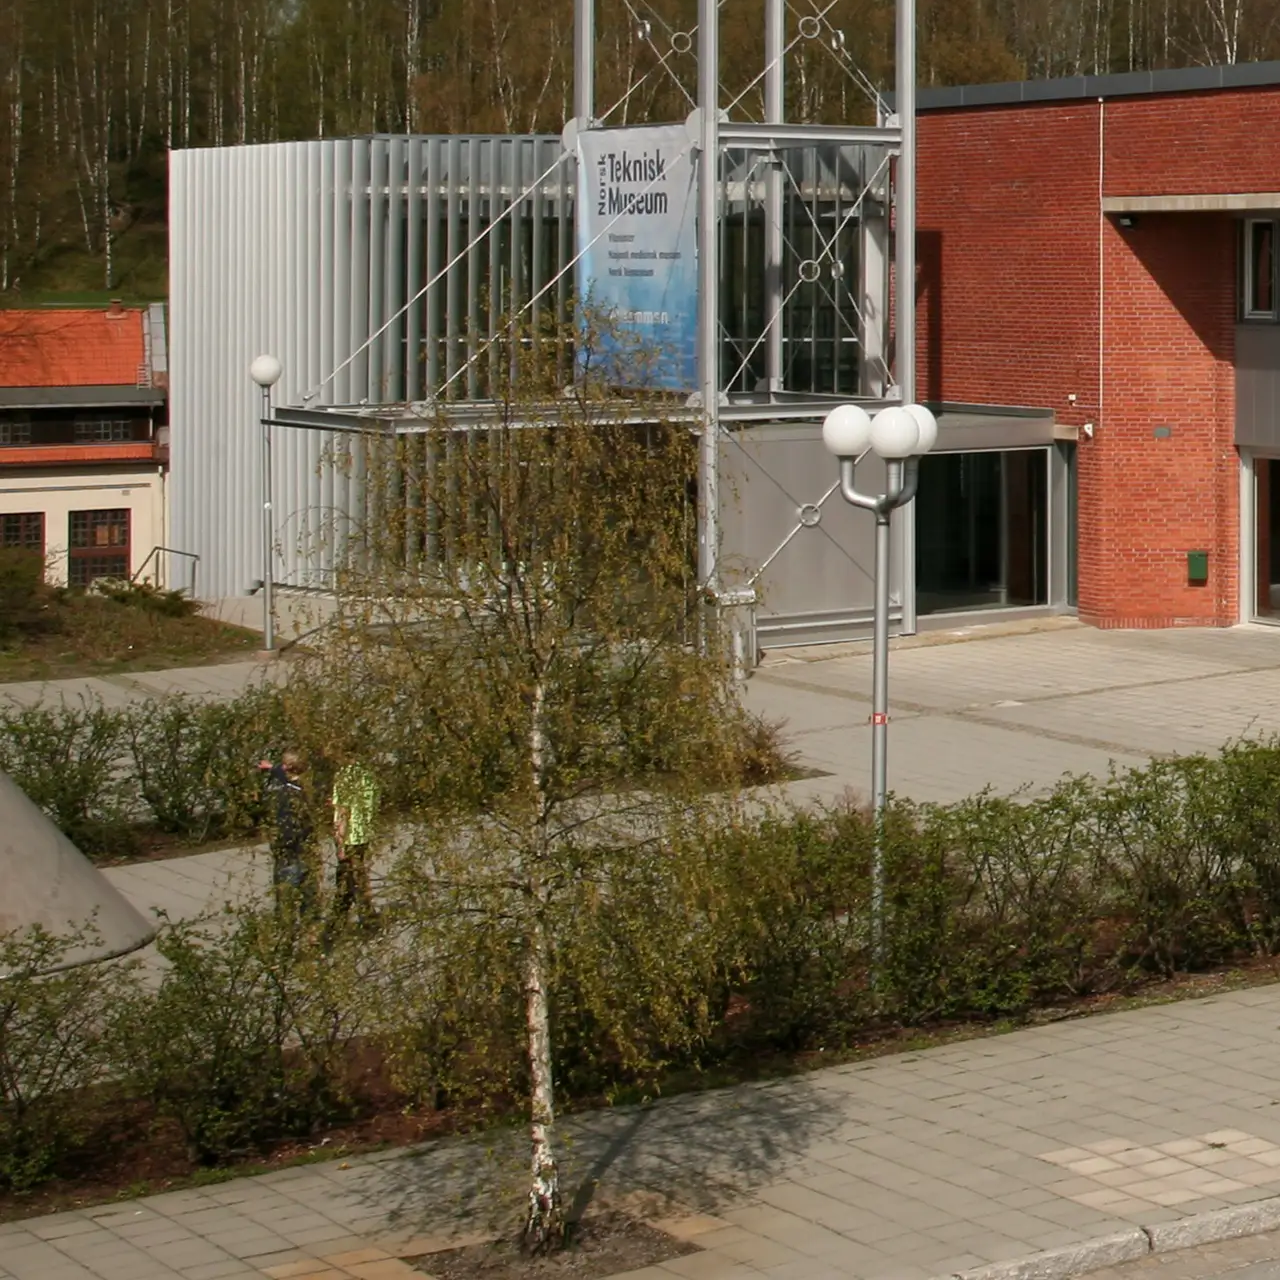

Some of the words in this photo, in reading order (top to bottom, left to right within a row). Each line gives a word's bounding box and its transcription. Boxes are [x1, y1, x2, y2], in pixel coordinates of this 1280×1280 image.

[608, 148, 667, 183] Teknisk
[598, 153, 606, 216] Norsk
[608, 186, 668, 215] Museum
